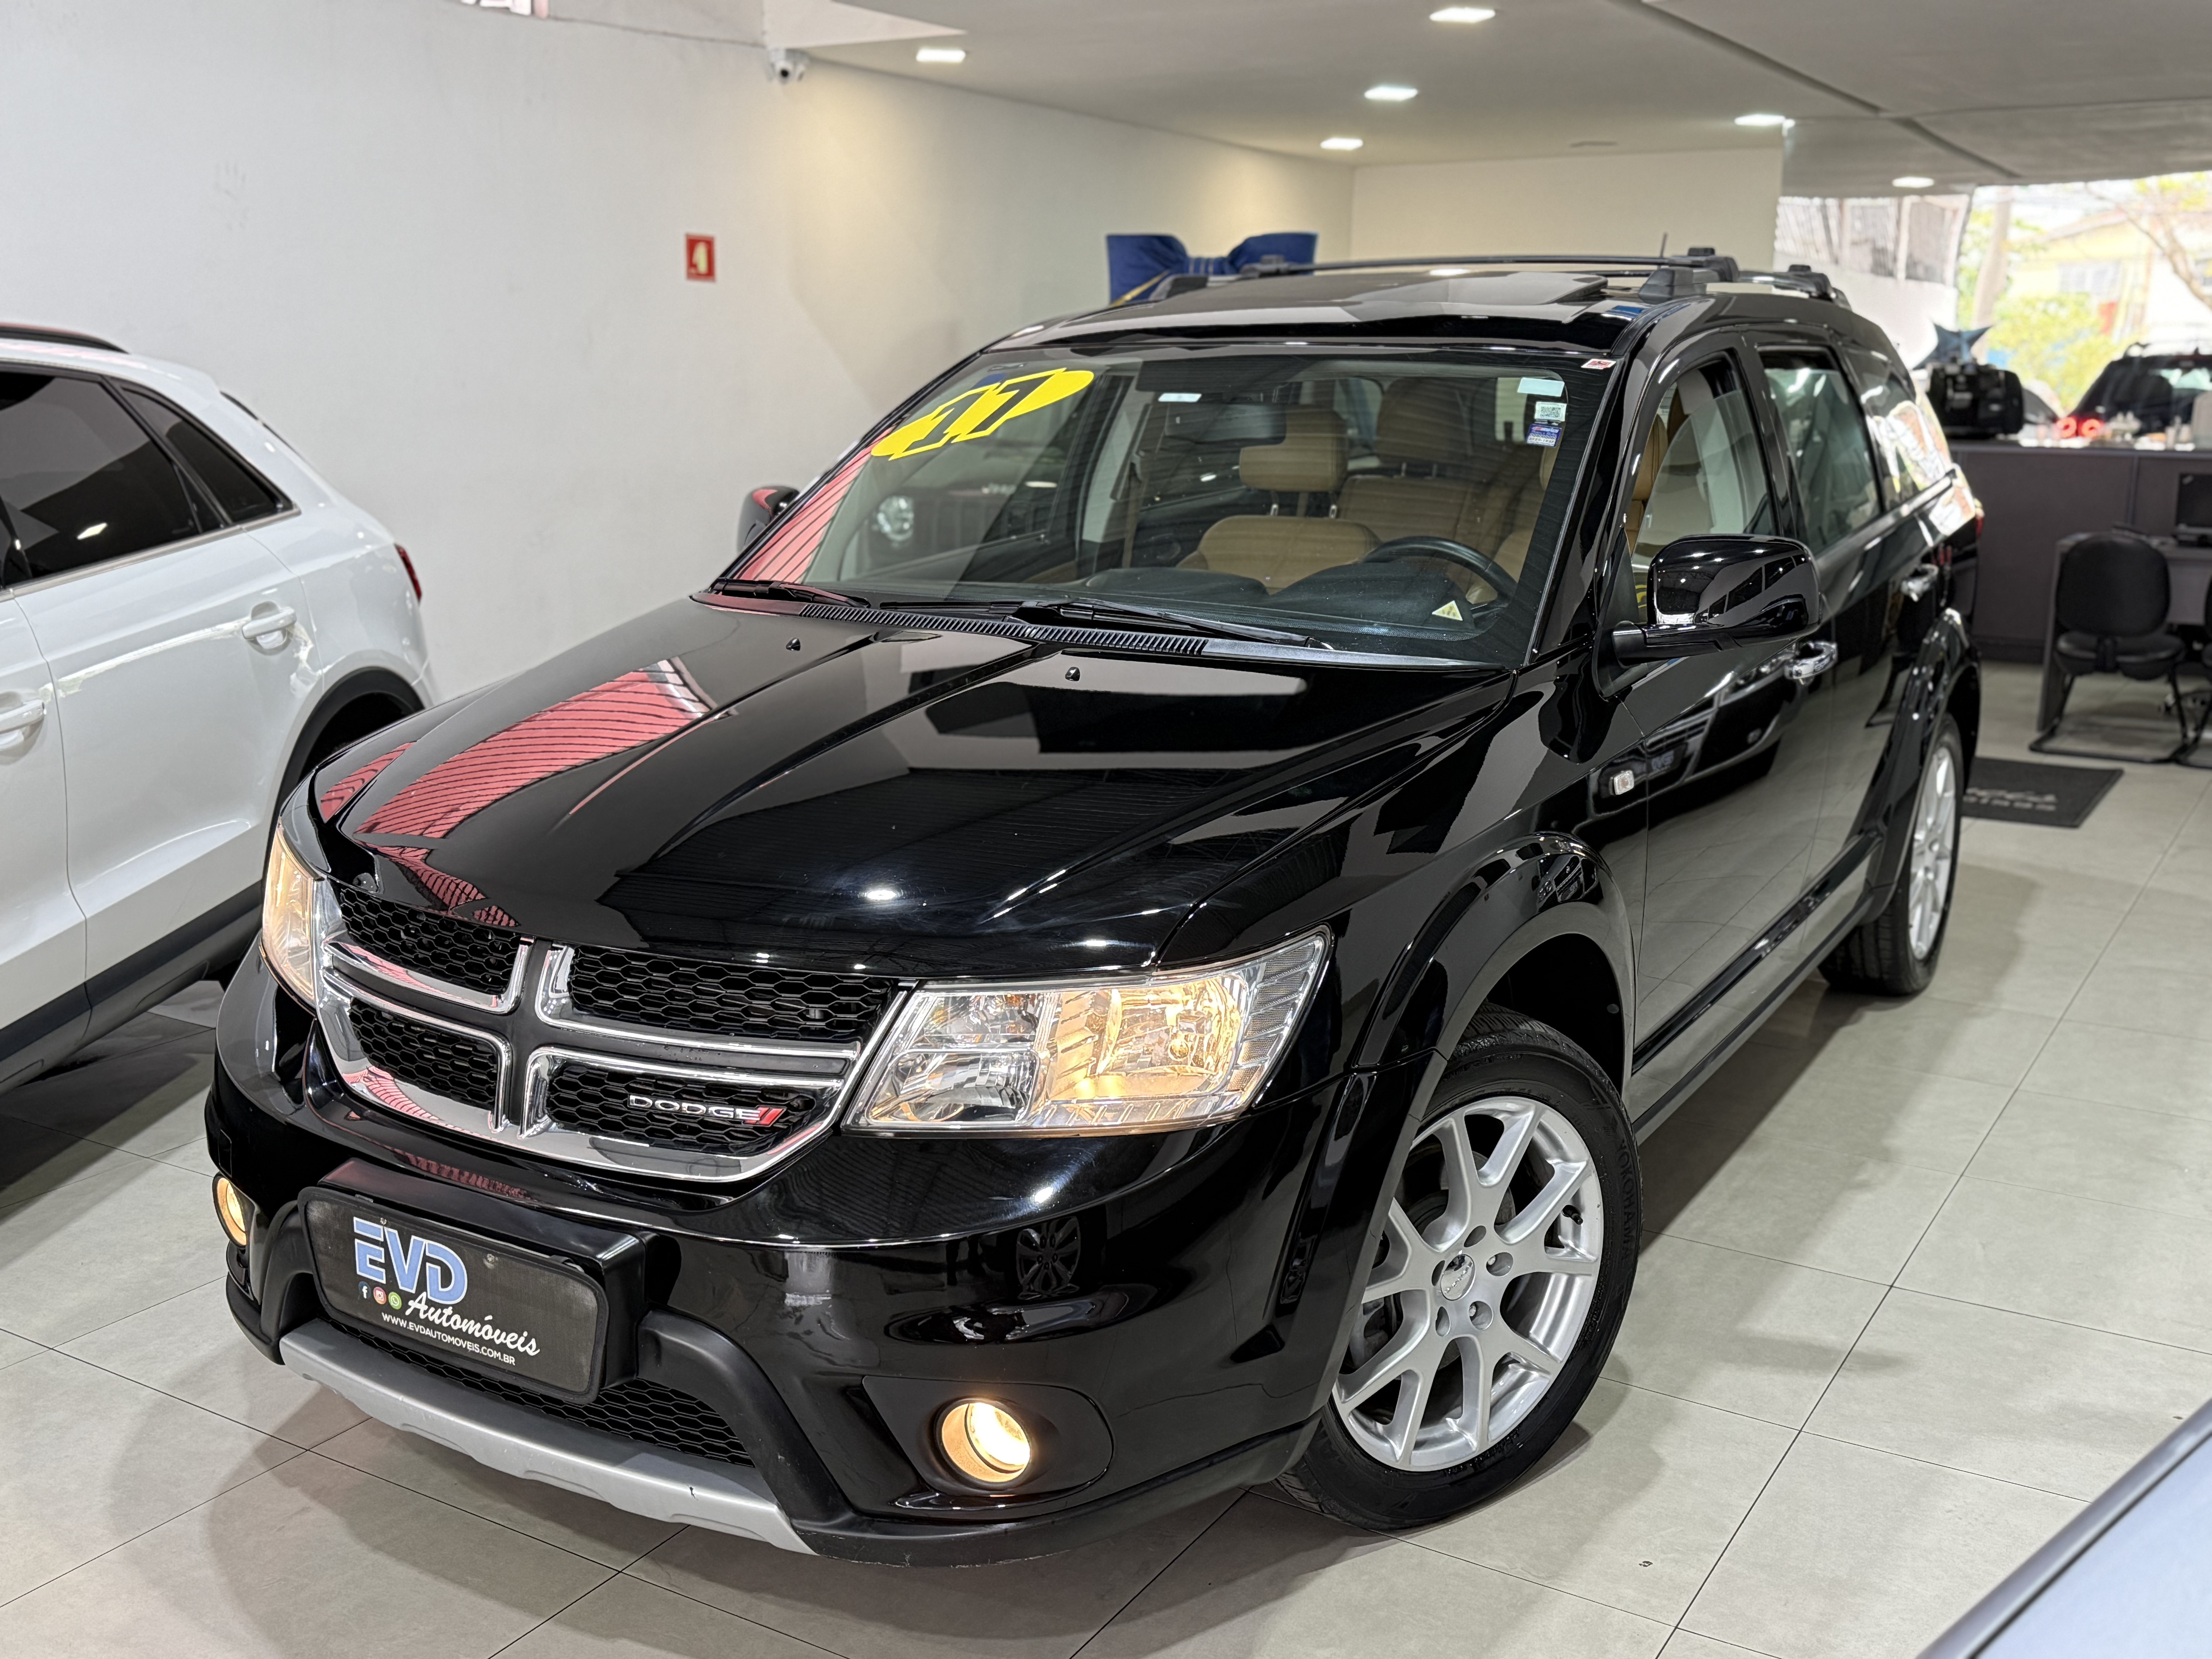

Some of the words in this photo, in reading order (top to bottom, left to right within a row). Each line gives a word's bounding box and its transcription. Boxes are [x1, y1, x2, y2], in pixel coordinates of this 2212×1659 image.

[629, 1094, 761, 1121] DODGE
[1616, 1139, 1636, 1261] YOKOHAMA
[353, 1216, 468, 1305] EVD
[381, 1312, 516, 1366] WWW.EVDAUTOMOVEIS.COM.BR
[405, 1291, 540, 1356] Automóveis
